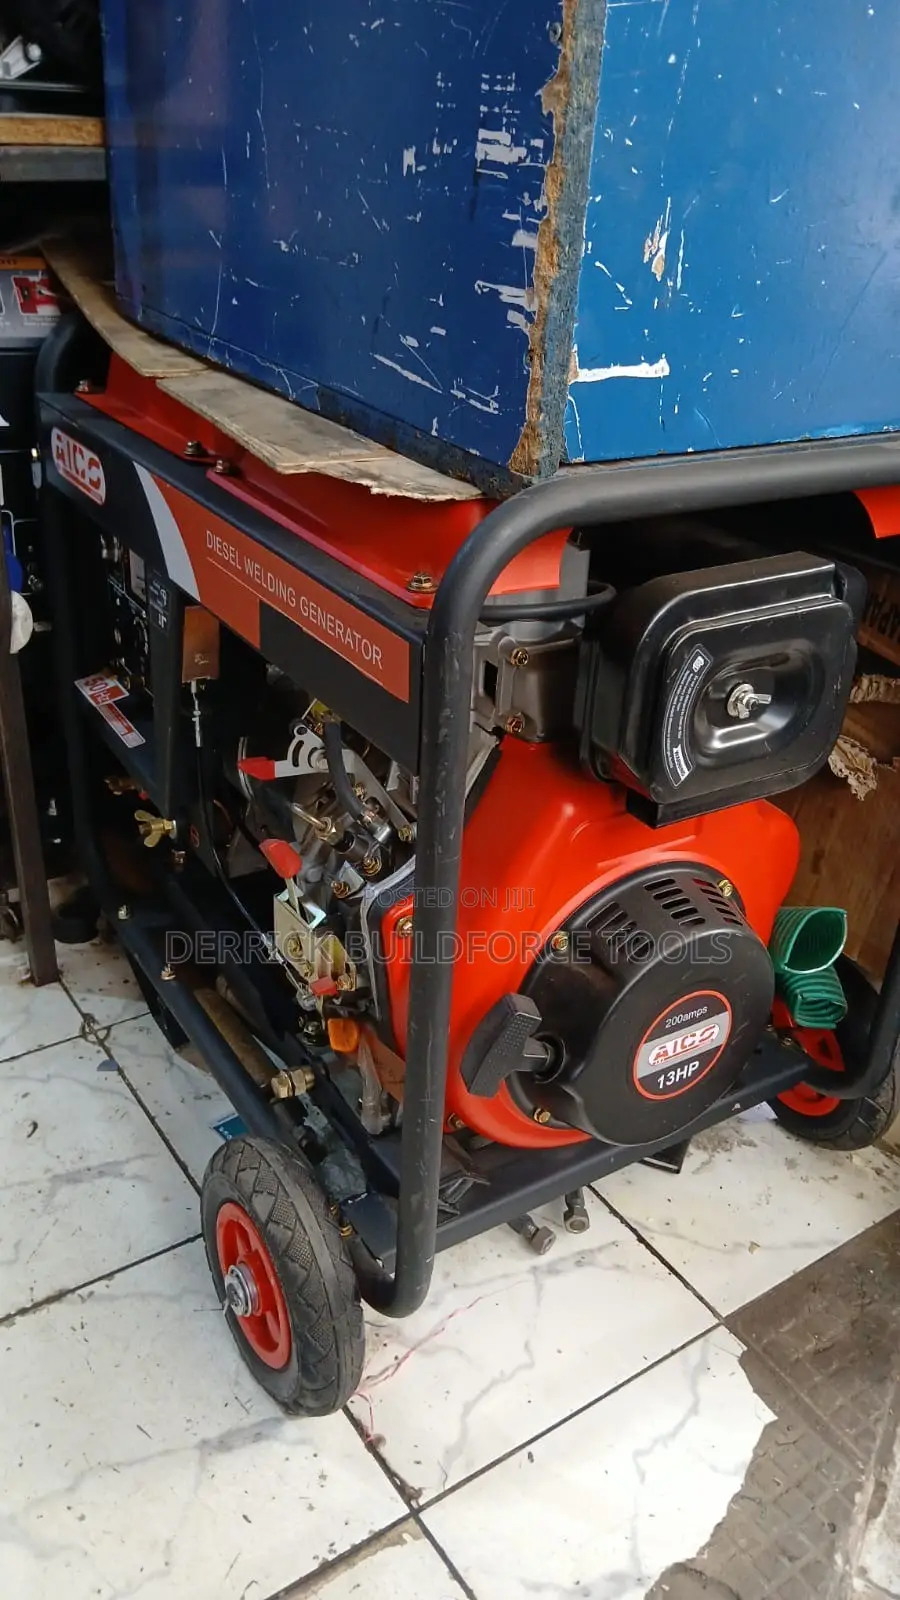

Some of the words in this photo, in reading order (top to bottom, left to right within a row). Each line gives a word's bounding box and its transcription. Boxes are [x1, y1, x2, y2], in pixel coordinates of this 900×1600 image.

[205, 529, 243, 571] DIESEL
[243, 555, 297, 608] WELDING
[299, 595, 383, 671] GENERATOR
[665, 1006, 709, 1028] 200amps
[657, 1061, 700, 1089] 13HP
